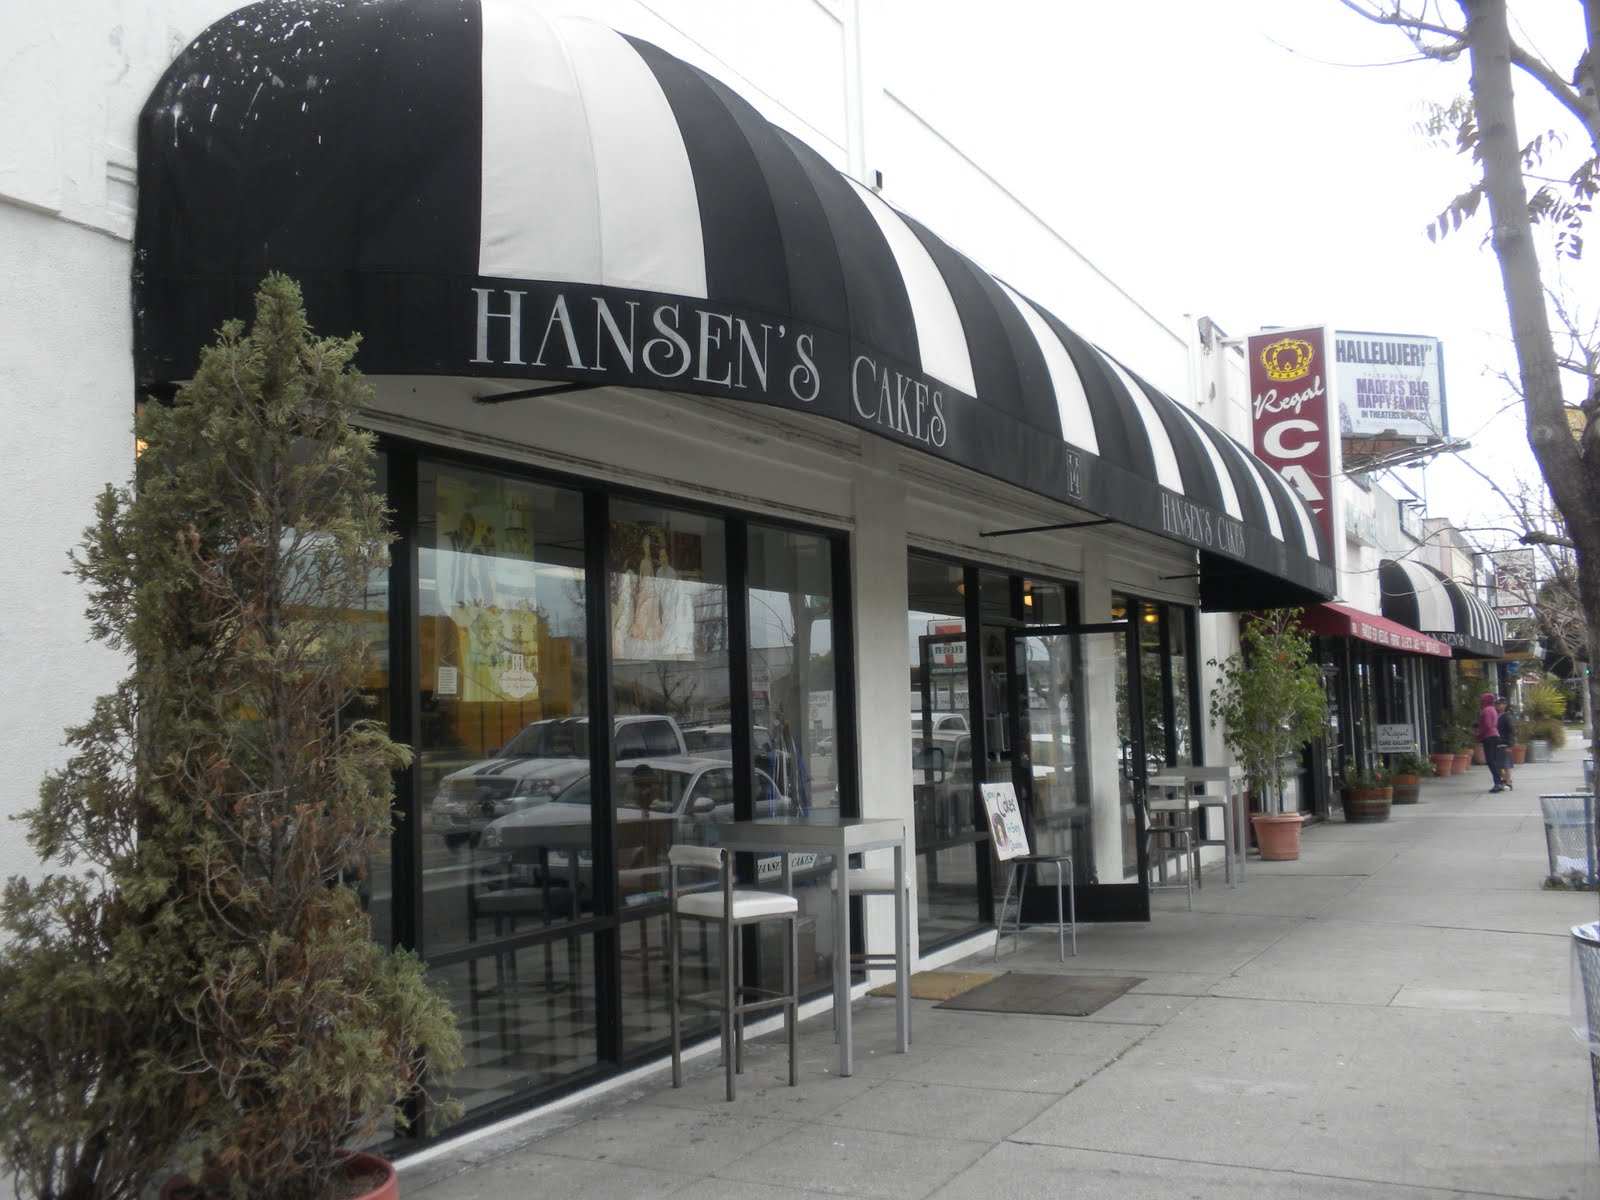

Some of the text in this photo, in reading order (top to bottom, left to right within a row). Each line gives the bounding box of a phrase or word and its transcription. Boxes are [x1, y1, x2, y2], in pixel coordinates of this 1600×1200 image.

[469, 287, 947, 448] HANSEN'S CAKES
[1254, 375, 1325, 420] Regal
[1356, 378, 1429, 397] MADEA'S BIG
[1357, 394, 1430, 411] HAPPY FAMILY
[1361, 410, 1369, 419] IN
[1369, 410, 1400, 419] THEATERS
[1161, 492, 1247, 559] HANSEN'S CAKES
[996, 792, 1016, 818] Cakes
[791, 855, 815, 868] CAKES
